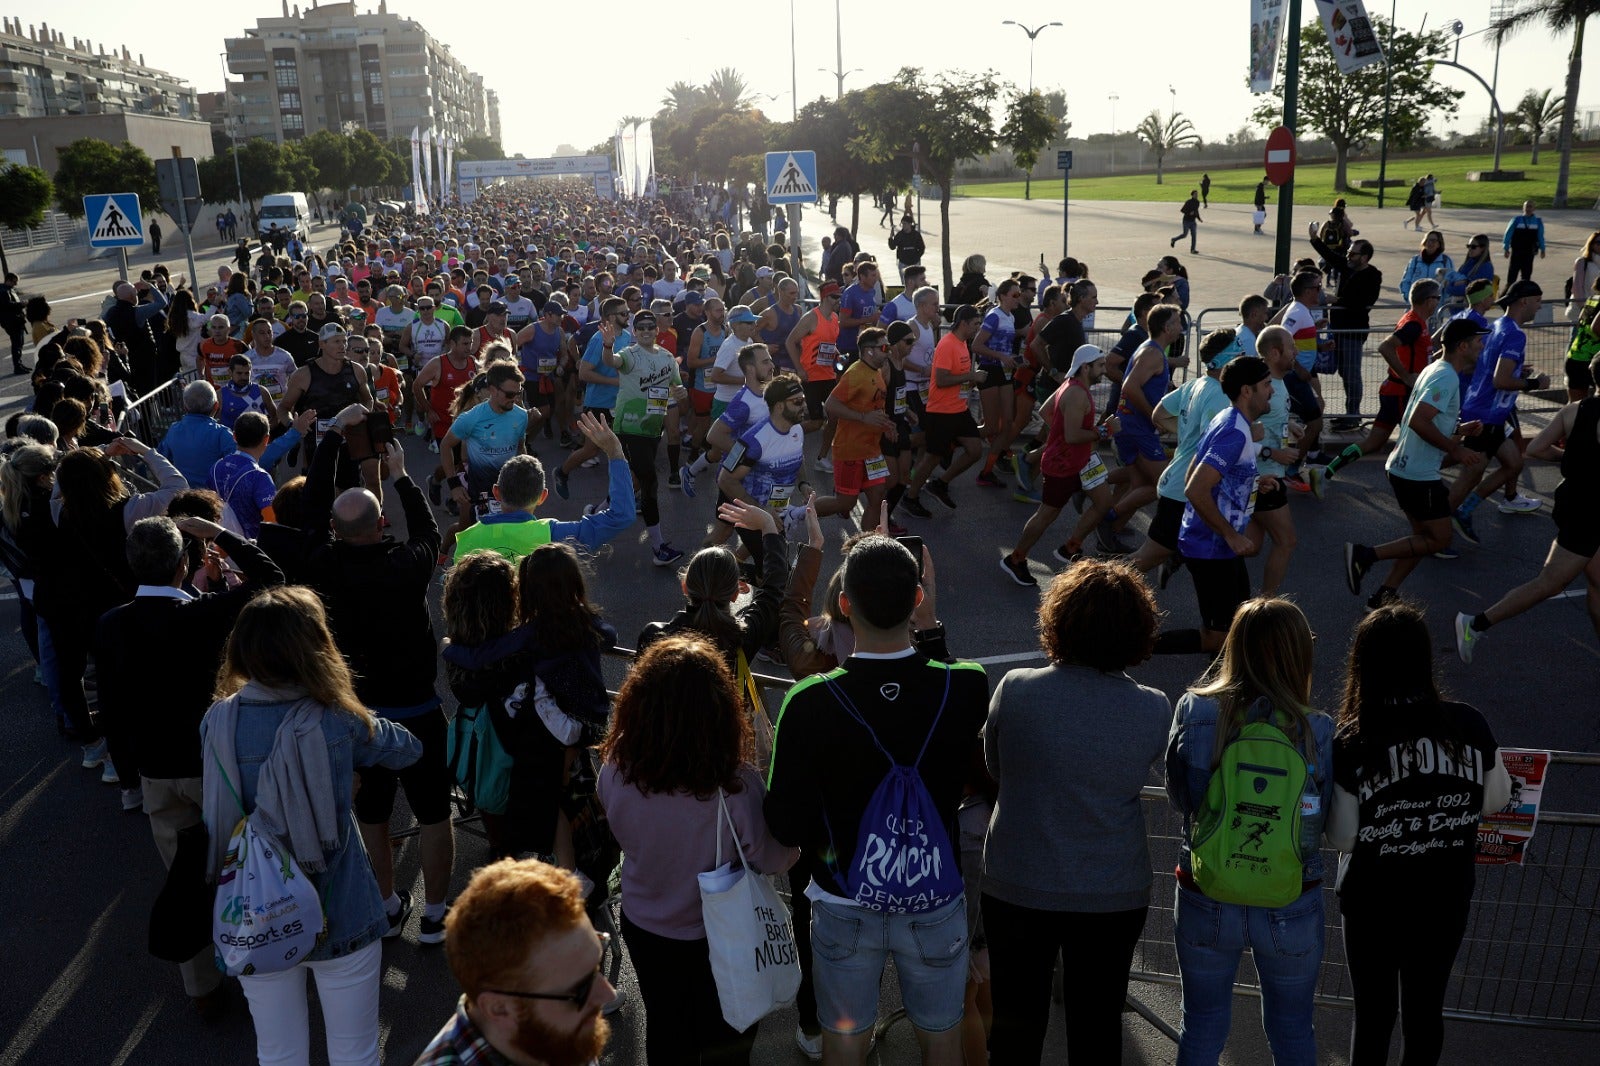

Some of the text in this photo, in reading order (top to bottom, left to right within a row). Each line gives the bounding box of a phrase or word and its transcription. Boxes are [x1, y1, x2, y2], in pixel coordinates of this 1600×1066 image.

[1375, 792, 1471, 819] Sportwear 1992
[1359, 818, 1403, 842] Ready
[1405, 816, 1423, 831] To
[1380, 843, 1398, 856] Los
[1452, 839, 1465, 847] ca
[859, 882, 940, 906] DENTAL
[755, 906, 777, 922] THE
